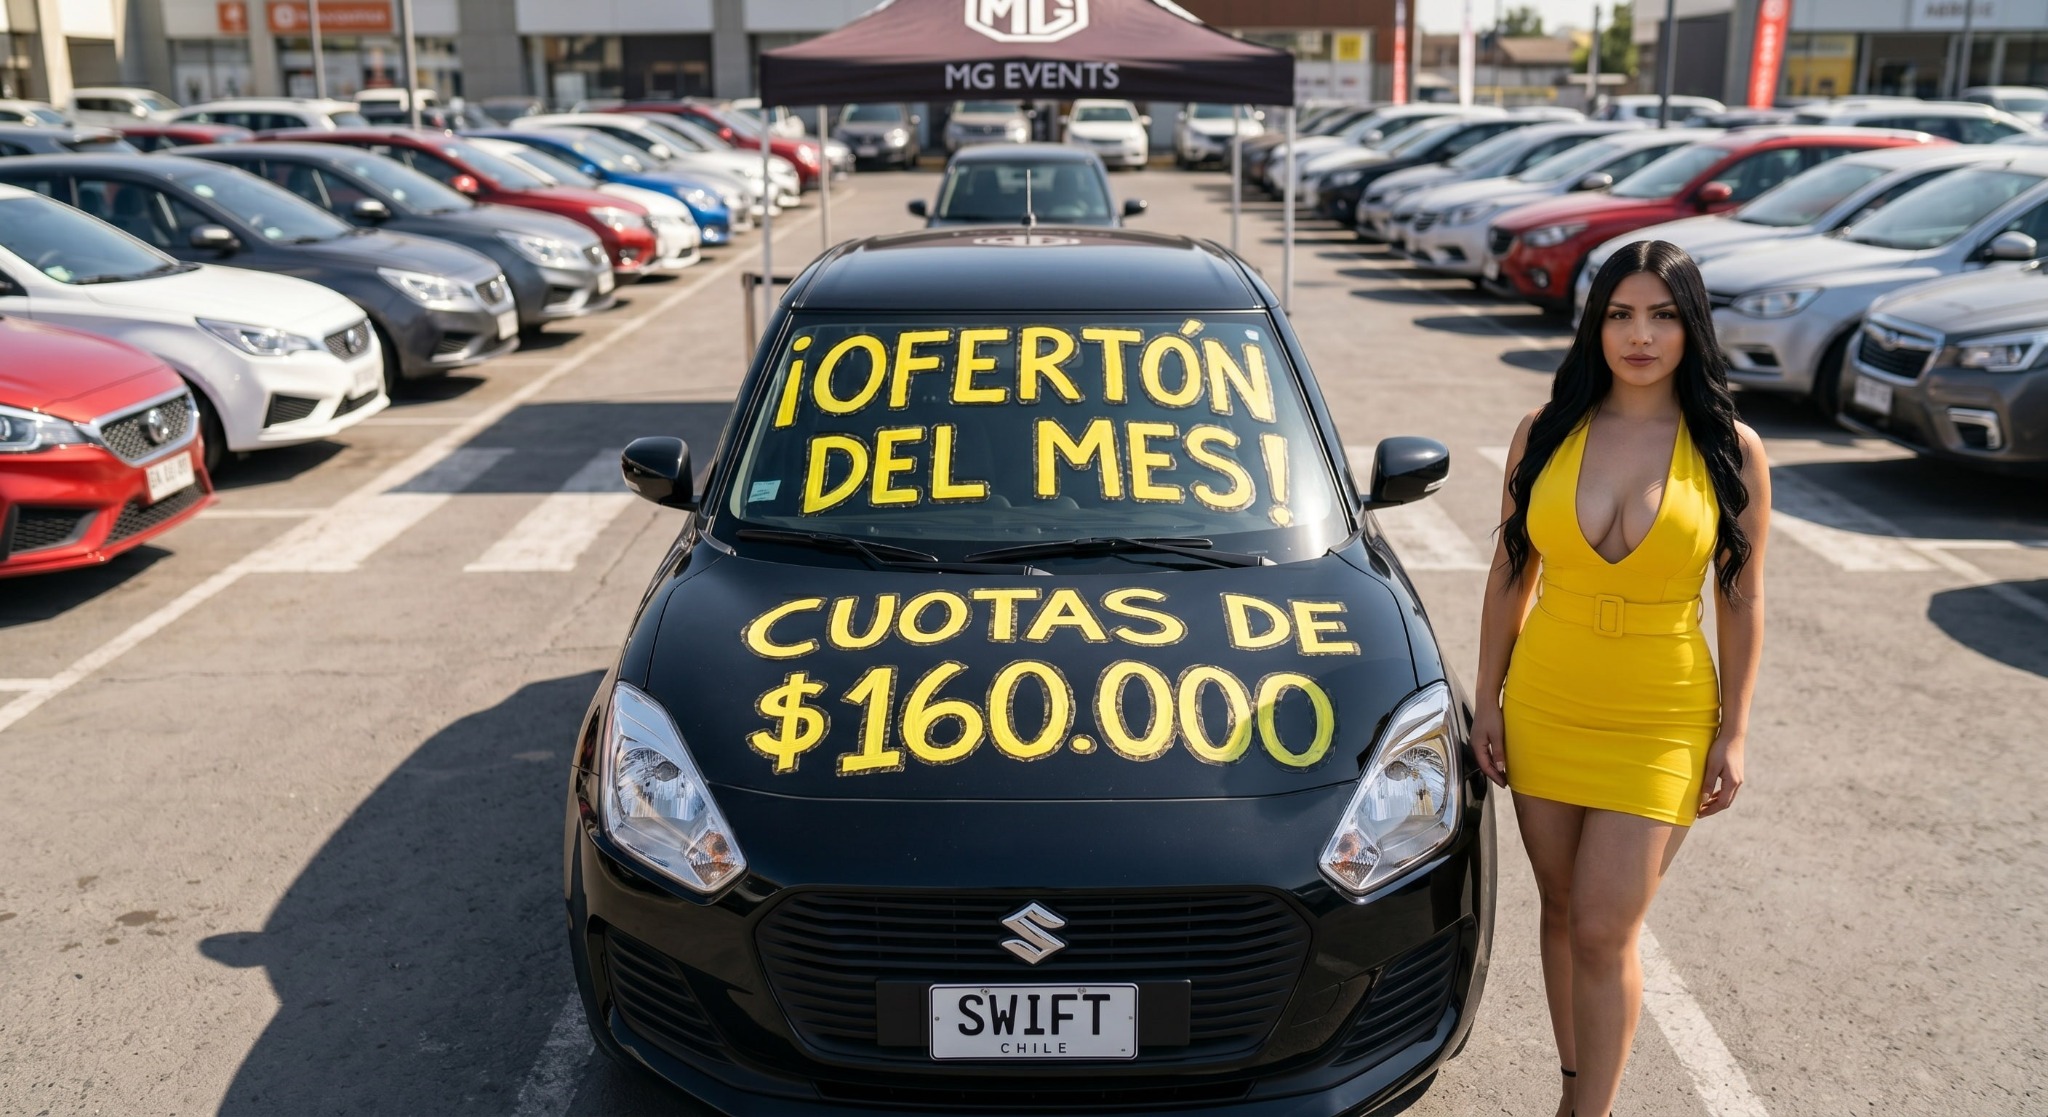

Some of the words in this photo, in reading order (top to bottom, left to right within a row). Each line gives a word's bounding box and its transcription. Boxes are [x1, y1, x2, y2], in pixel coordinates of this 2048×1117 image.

[978, 0, 1076, 35] MG
[946, 63, 995, 90] MG
[1005, 62, 1120, 90] EVENTS
[773, 319, 1276, 429] ¡OFERTÓN
[799, 423, 990, 516] DEL
[1033, 417, 1292, 527] MES!
[741, 588, 1187, 660] CUOTAS
[1220, 592, 1361, 656] DE
[746, 659, 1338, 776] $160.000
[958, 994, 1111, 1036] SWIFT
[1000, 1042, 1068, 1054] CHILE
